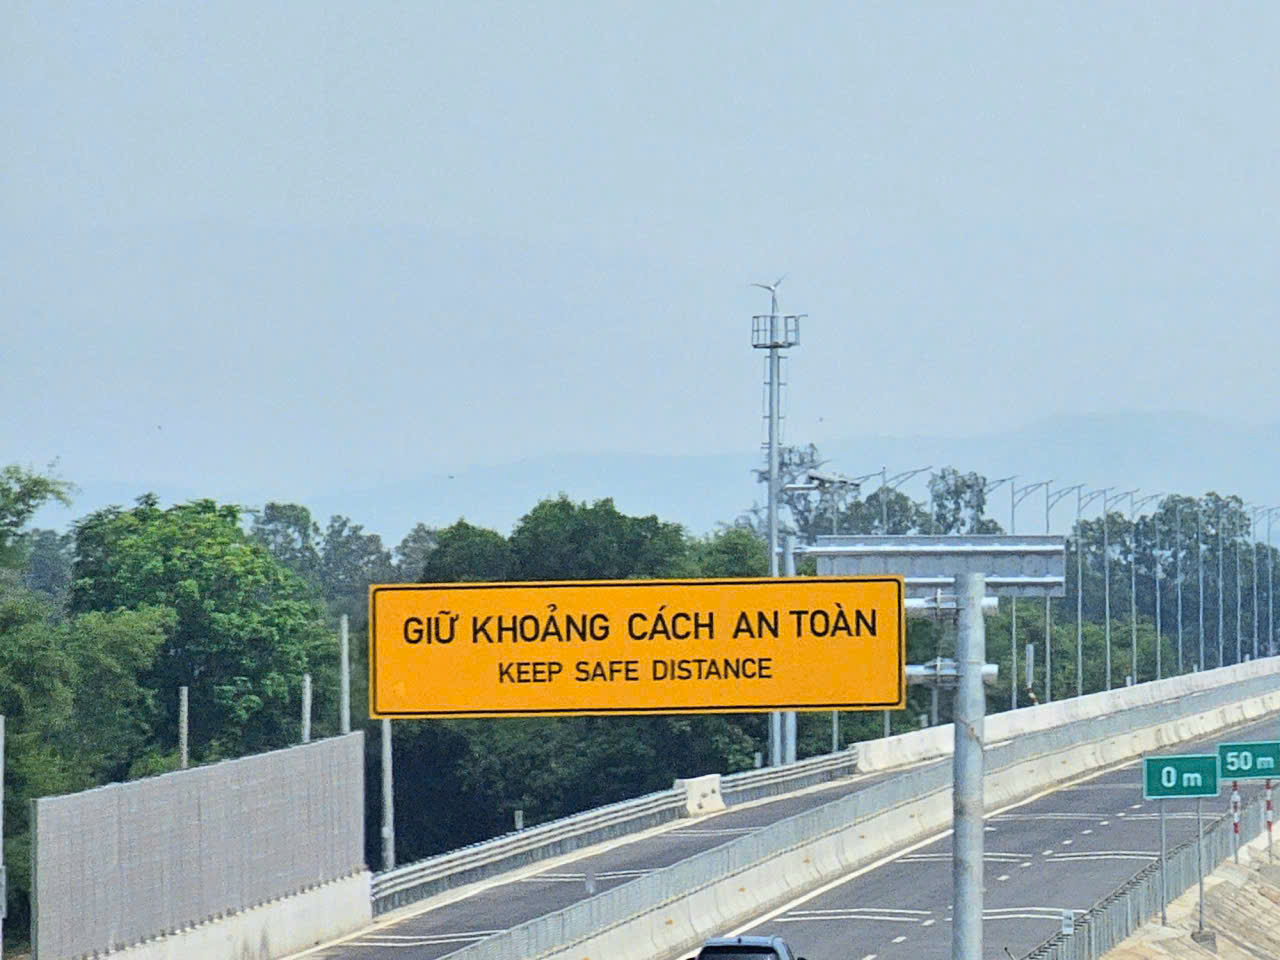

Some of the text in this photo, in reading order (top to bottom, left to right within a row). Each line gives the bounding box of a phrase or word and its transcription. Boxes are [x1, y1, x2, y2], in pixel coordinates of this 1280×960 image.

[403, 603, 877, 645] GIỮ KHOẢNG CÁCH AN TOÀN
[498, 658, 773, 683] KEEP SAFE DISTANCE
[1226, 751, 1274, 770] 50 m
[1161, 766, 1202, 788] 0 m
